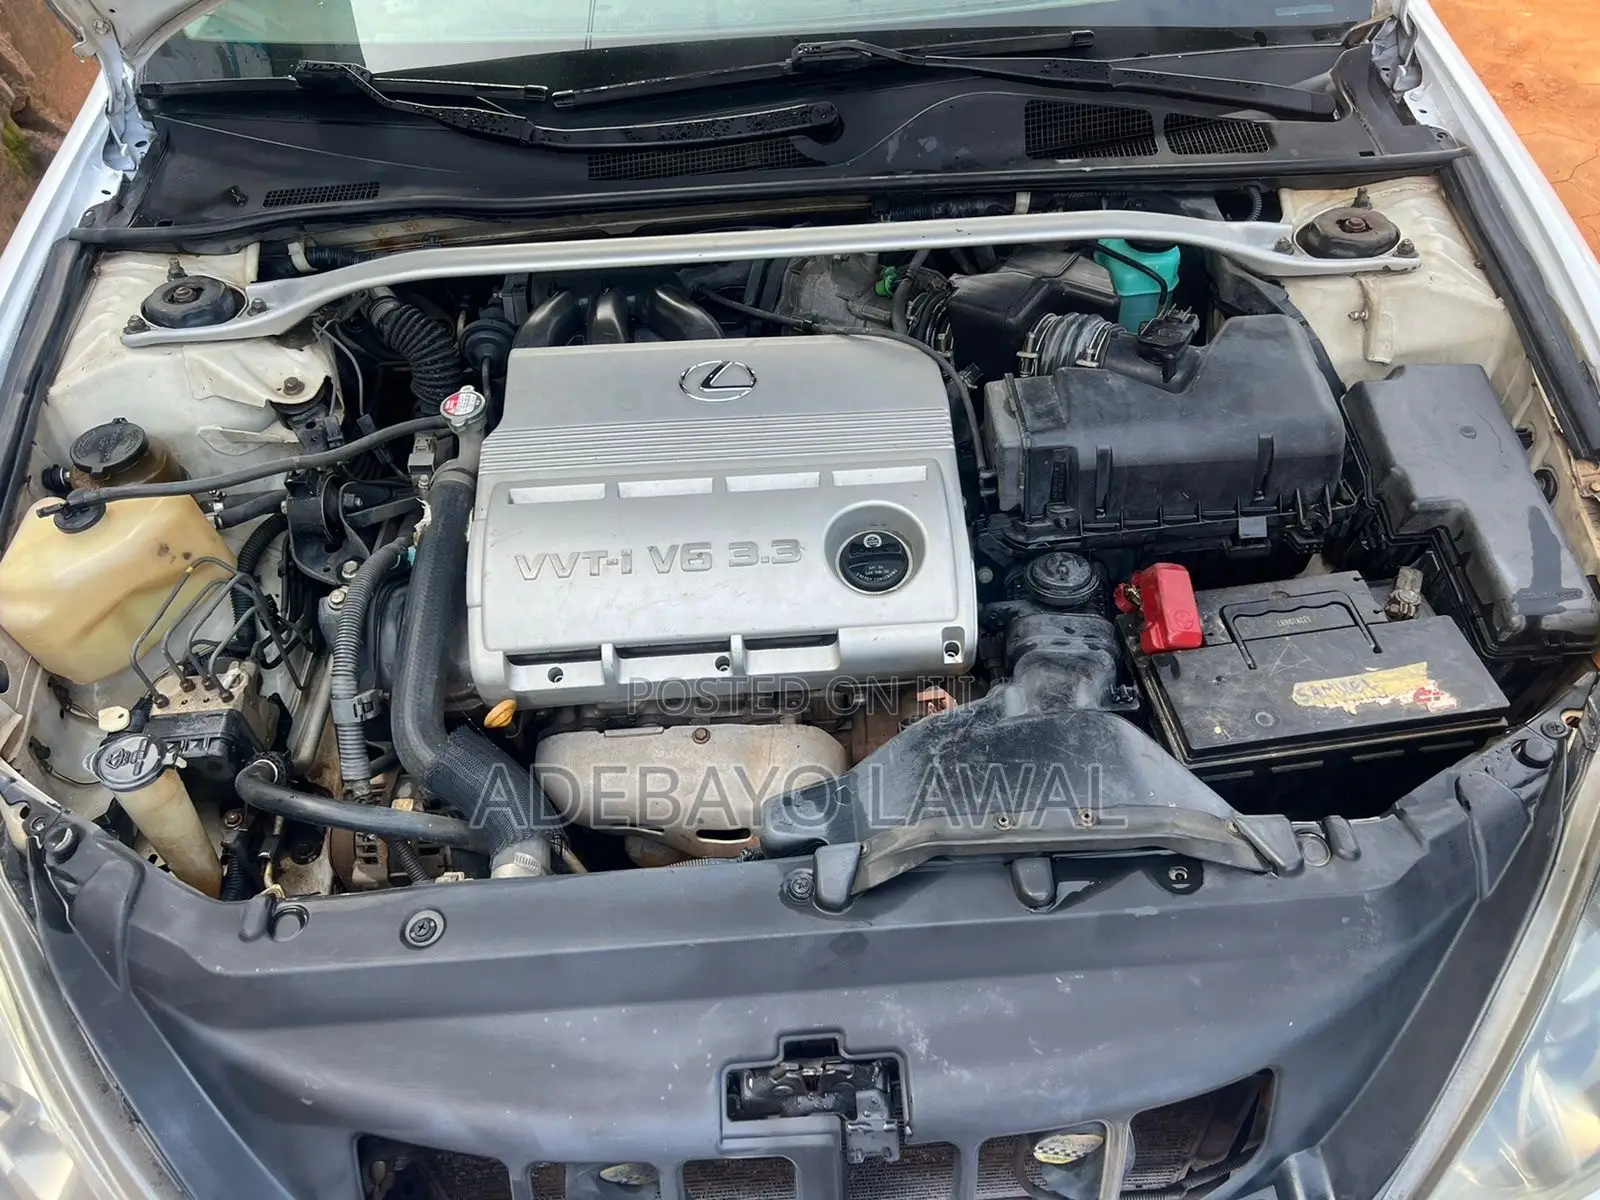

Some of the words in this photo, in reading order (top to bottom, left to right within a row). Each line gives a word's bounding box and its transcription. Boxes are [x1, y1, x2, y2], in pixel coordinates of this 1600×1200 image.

[514, 549, 632, 581] VVT-i
[648, 541, 713, 574] V6
[728, 539, 802, 567] 3.3
